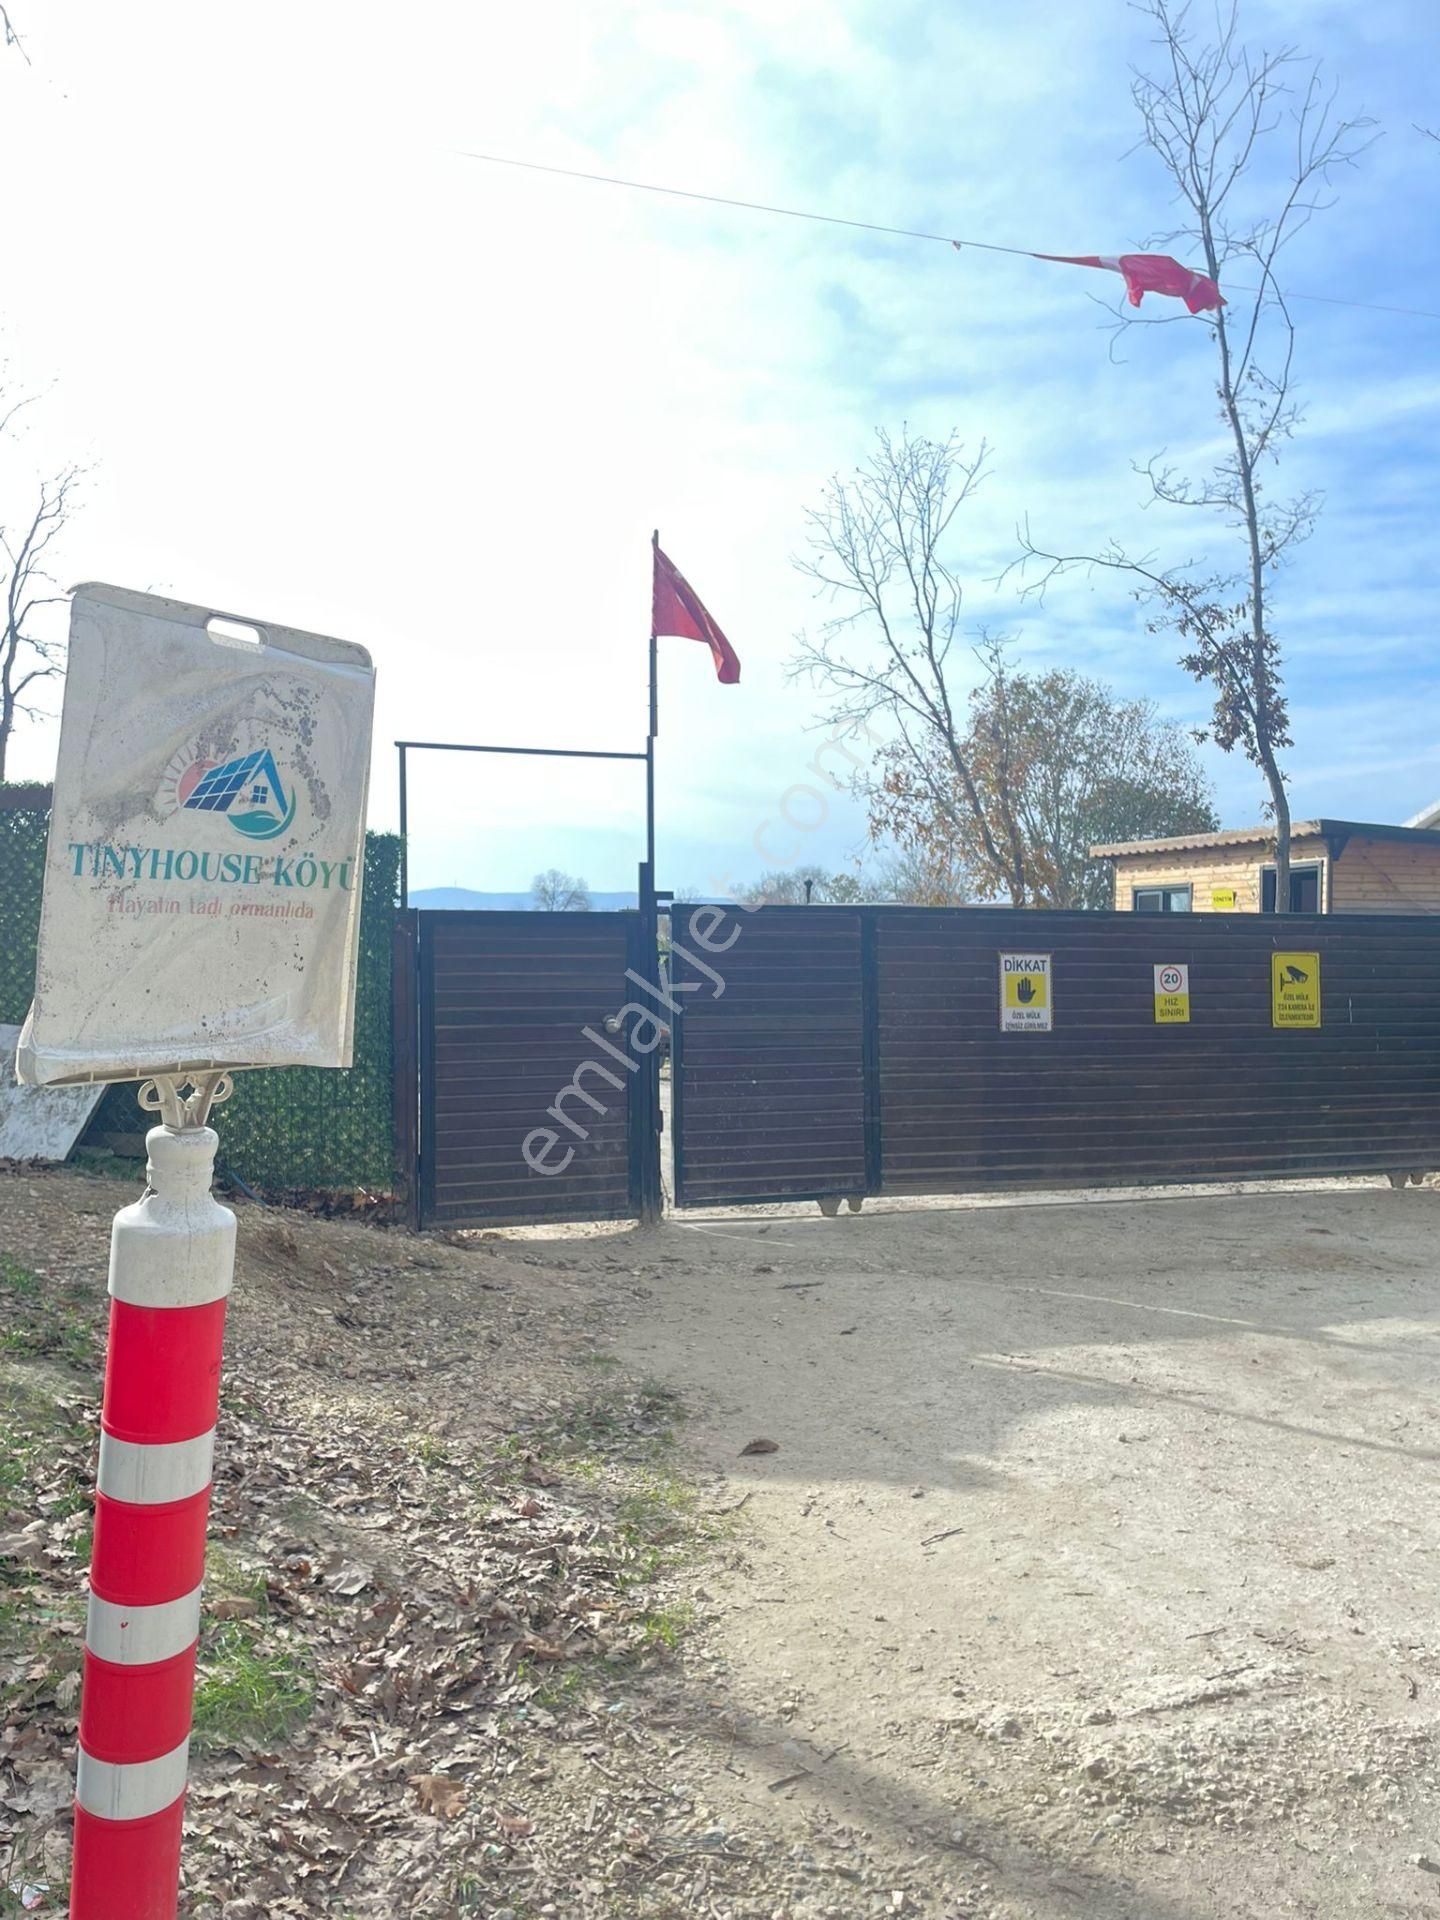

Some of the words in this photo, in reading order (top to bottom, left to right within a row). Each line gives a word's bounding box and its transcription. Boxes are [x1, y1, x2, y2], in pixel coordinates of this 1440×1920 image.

[68, 843, 264, 885] TINYHOUSE
[274, 852, 356, 891] KÖYÜ
[1004, 956, 1047, 972] DİKKAT
[1164, 973, 1179, 984] 20
[1164, 997, 1179, 1006] HIZ
[1159, 1008, 1185, 1017] SINIRI
